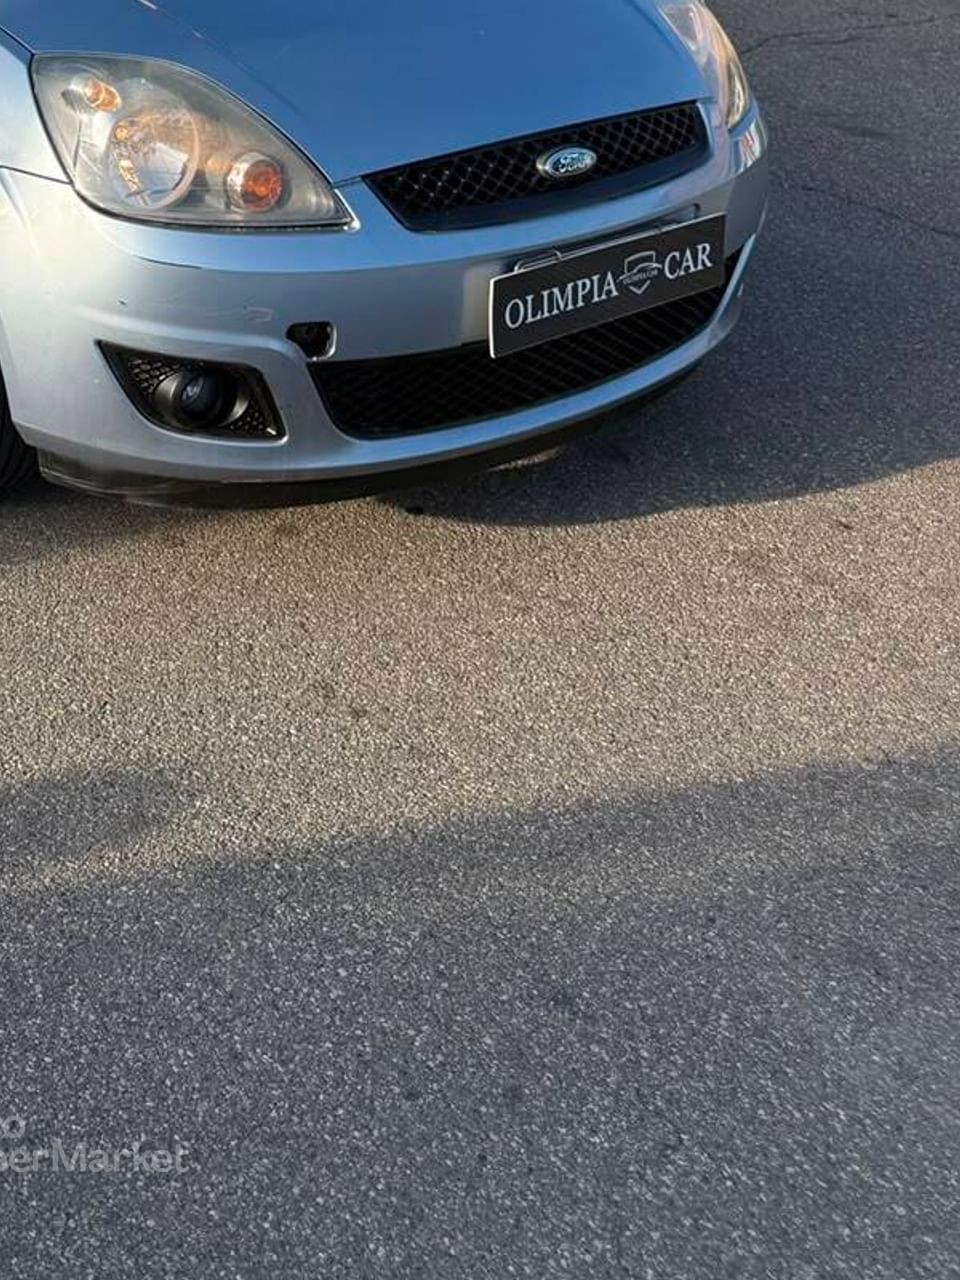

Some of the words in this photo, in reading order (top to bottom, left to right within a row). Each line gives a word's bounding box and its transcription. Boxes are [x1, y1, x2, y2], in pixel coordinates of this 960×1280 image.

[558, 152, 593, 173] Ford
[504, 271, 620, 329] OLIMPIA
[664, 242, 713, 280] CAR
